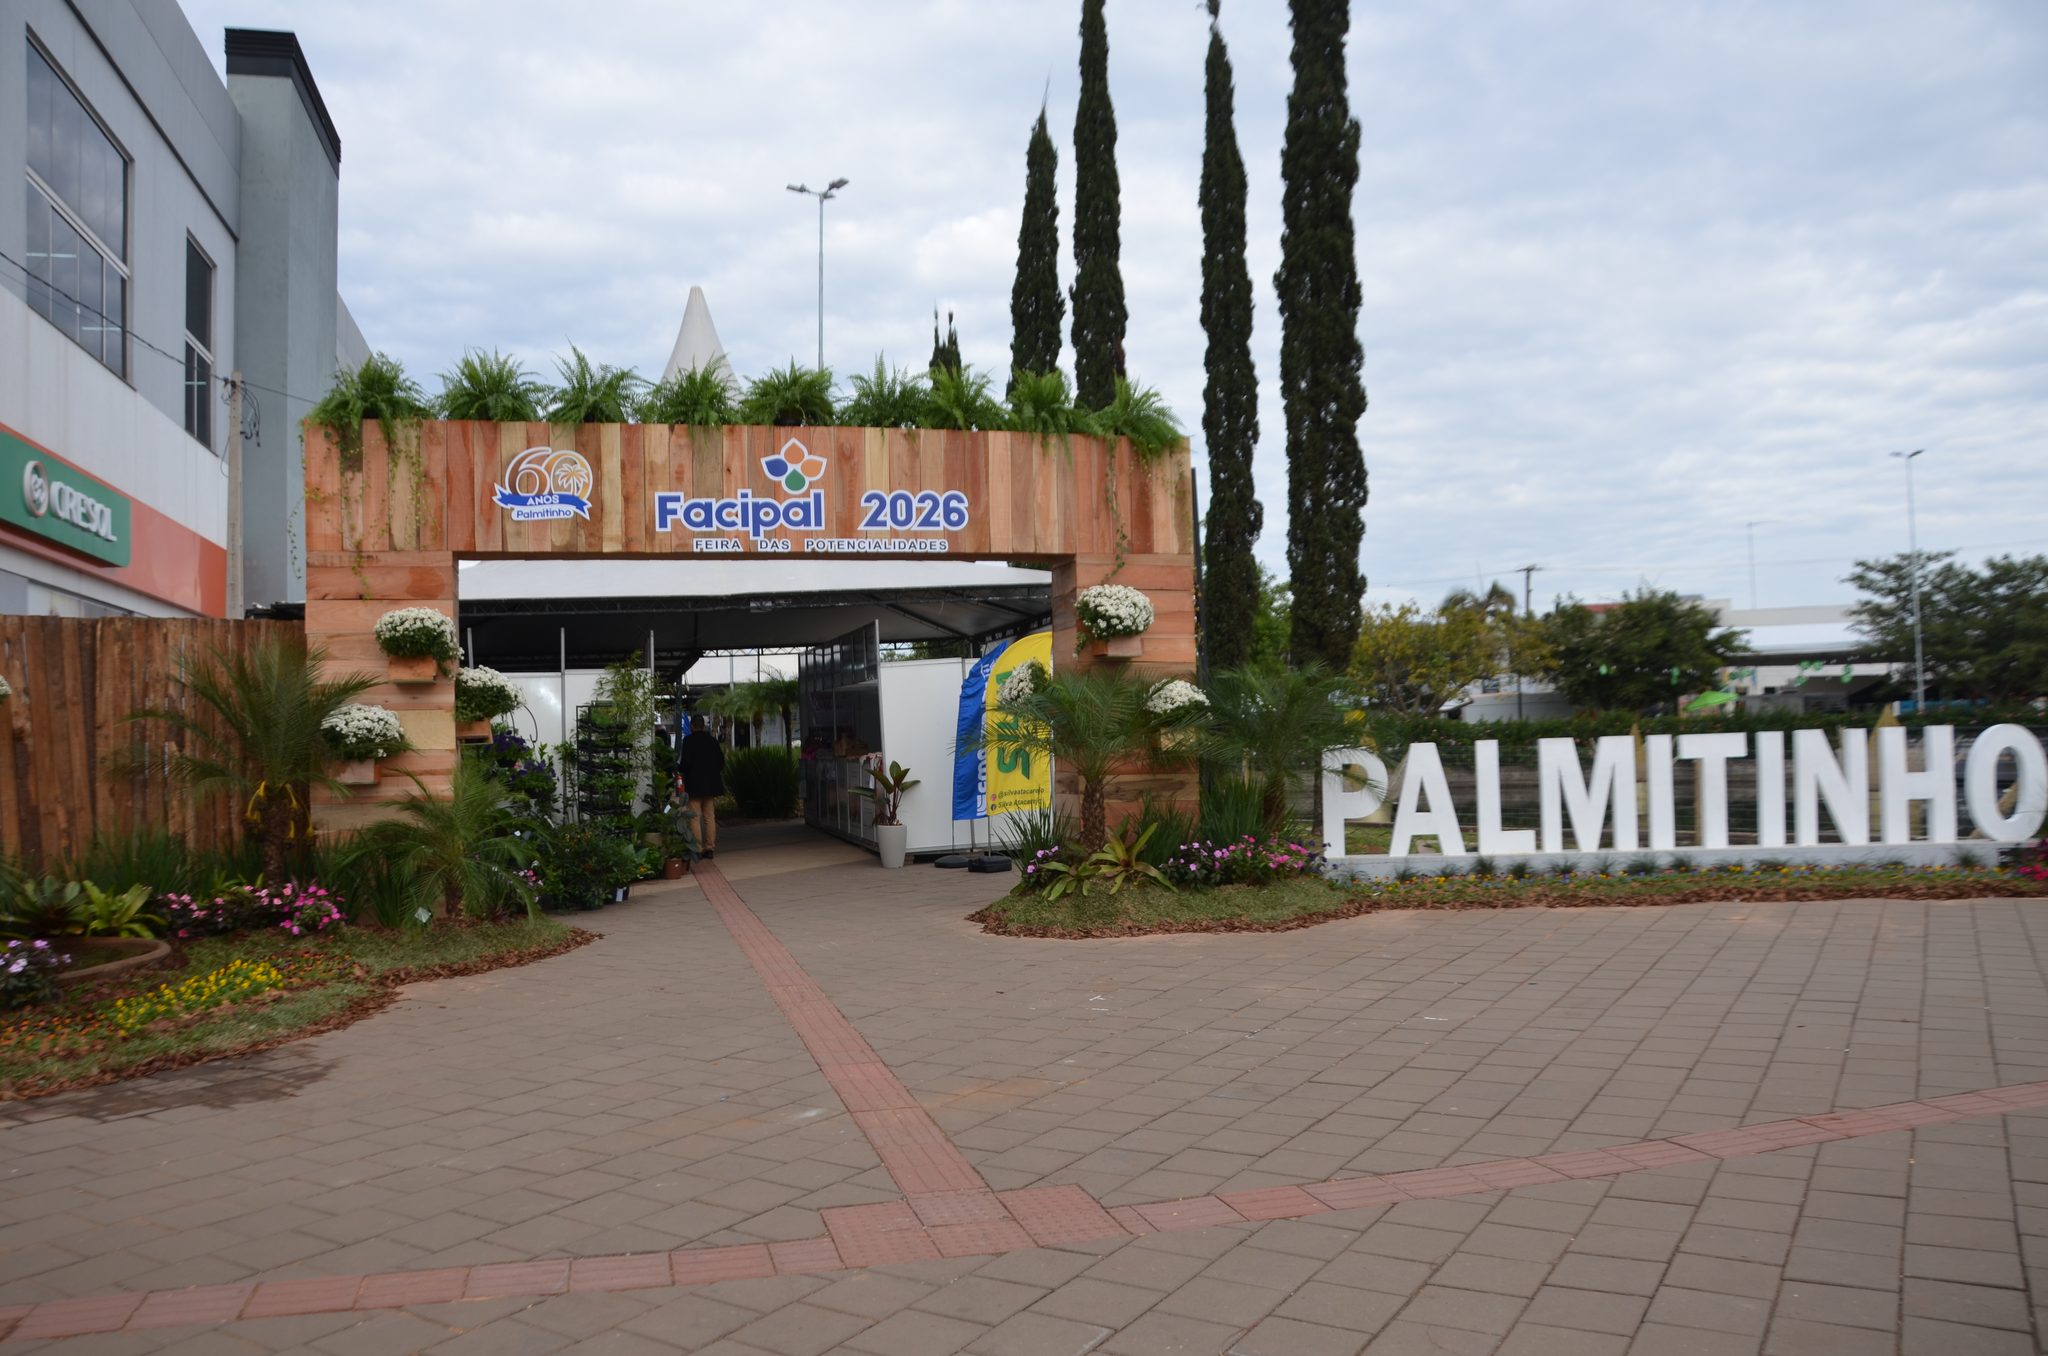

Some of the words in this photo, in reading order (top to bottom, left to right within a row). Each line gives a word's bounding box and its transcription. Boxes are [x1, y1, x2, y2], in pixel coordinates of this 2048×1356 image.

[505, 447, 593, 500] 60
[50, 481, 117, 541] CRESOL
[516, 508, 572, 519] Palmitinho
[526, 494, 560, 505] ANOS
[656, 490, 824, 538] Facipal
[860, 491, 968, 530] 2026
[695, 539, 741, 550] FEIRA
[759, 539, 790, 550] DAS
[805, 539, 948, 550] POTENCIALIDADES
[1321, 723, 2047, 858] PALMITINHO
